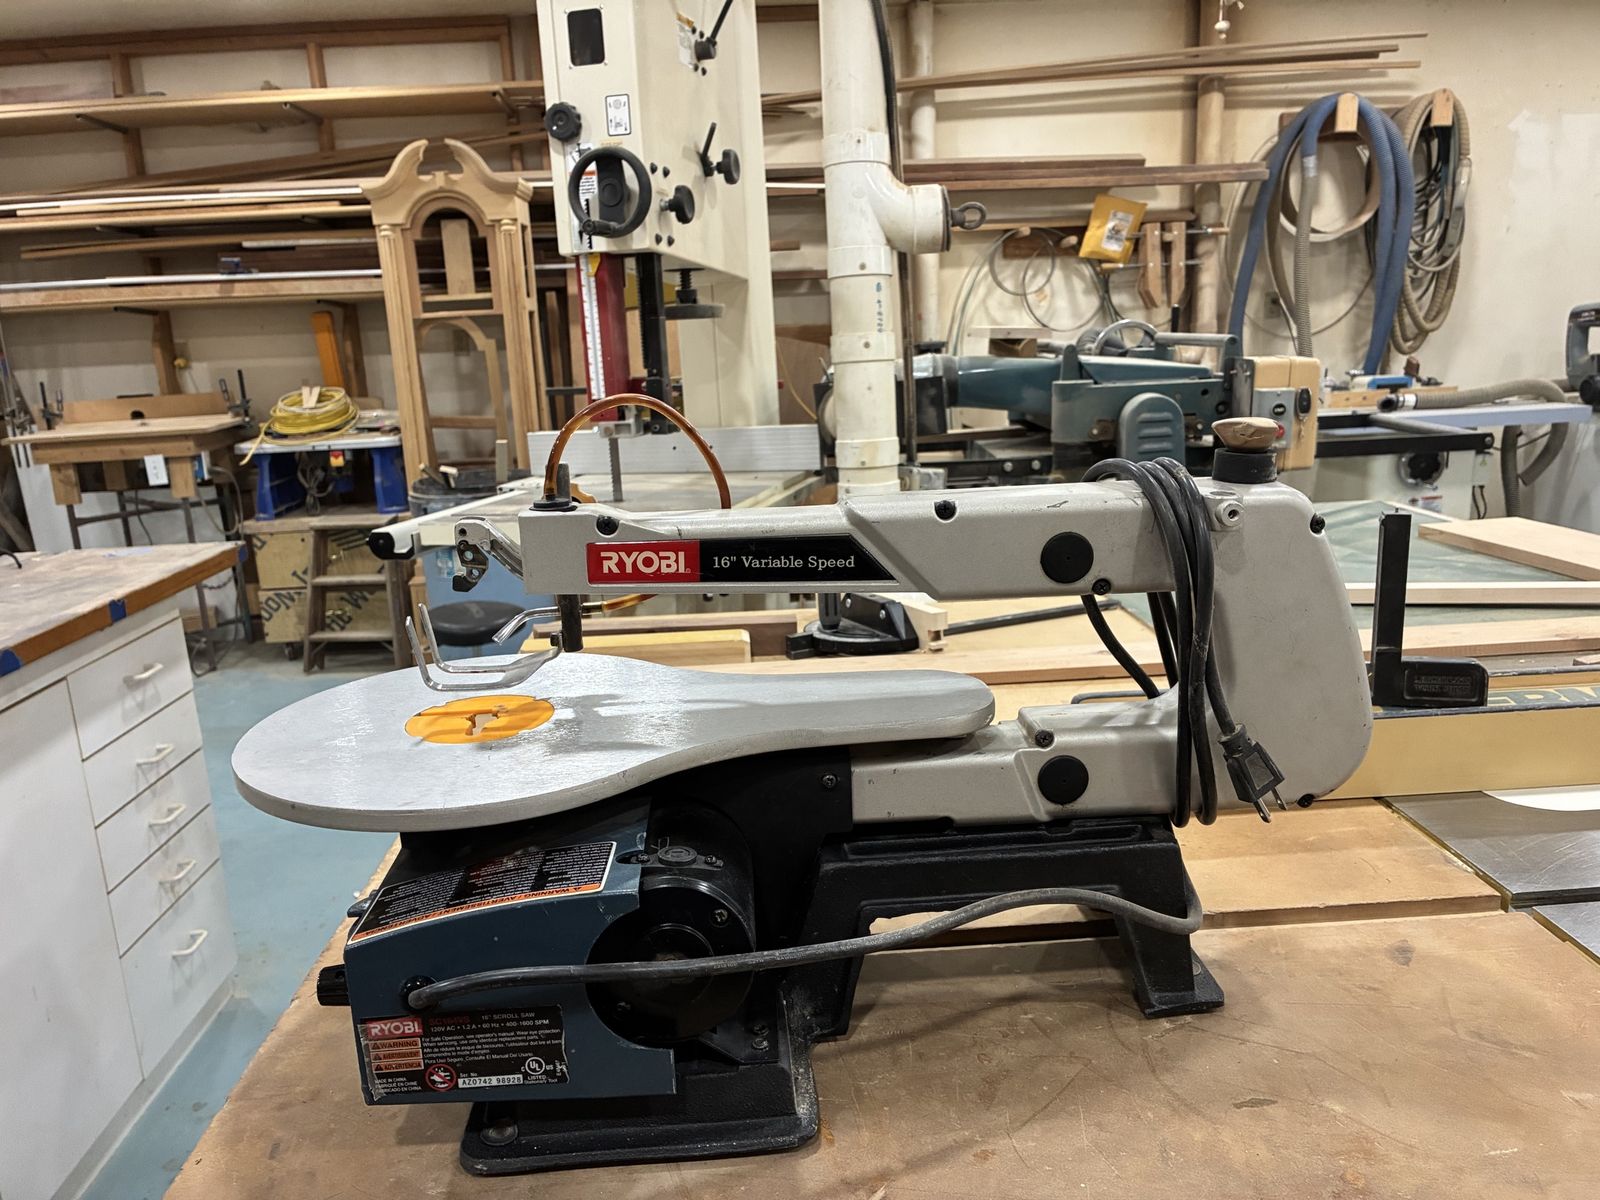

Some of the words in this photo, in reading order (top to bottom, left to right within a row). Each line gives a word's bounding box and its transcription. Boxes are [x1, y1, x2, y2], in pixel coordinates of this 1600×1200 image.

[600, 551, 685, 574] RYOBI
[713, 556, 737, 568] 16"
[741, 556, 803, 568] Variable
[808, 556, 855, 570] Speed
[370, 1021, 419, 1036] RYOBI
[380, 1040, 418, 1050] WARNING
[529, 1060, 541, 1071] UL
[461, 1077, 493, 1086] AZ0742
[496, 1076, 522, 1084] 98928
